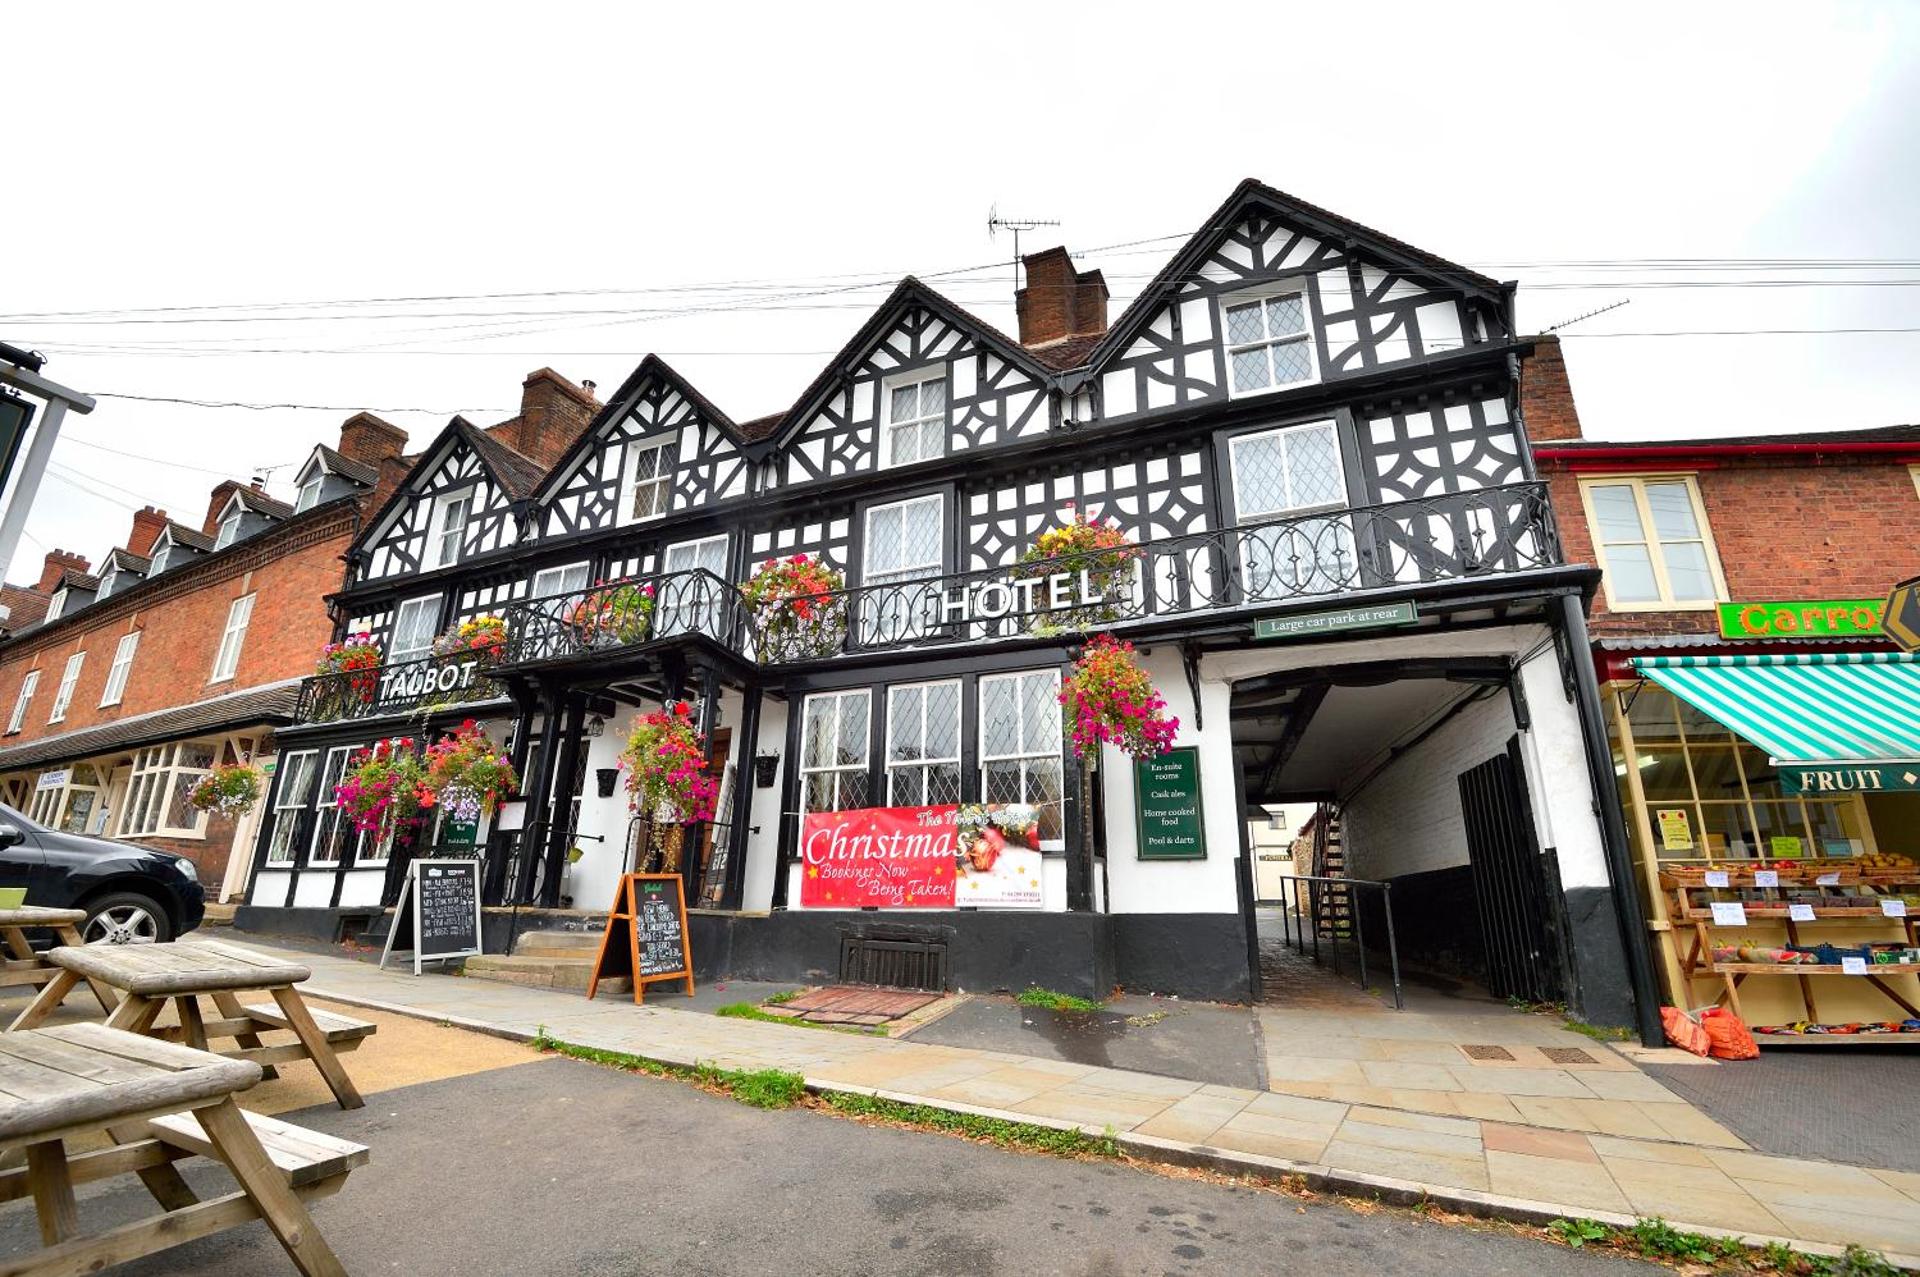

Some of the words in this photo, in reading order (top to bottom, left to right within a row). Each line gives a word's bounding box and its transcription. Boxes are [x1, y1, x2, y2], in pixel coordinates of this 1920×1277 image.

[941, 569, 1103, 624] HOTEL
[1270, 620, 1304, 632] Large
[1306, 618, 1326, 627] car
[1329, 612, 1355, 627] park
[1358, 612, 1370, 622] at
[1373, 610, 1398, 620] rear
[379, 661, 478, 701] TALBOT
[1799, 769, 1883, 791] FRUIT
[917, 809, 943, 827] The
[1144, 809, 1167, 817] Home
[1168, 807, 1196, 816] cooked
[1161, 817, 1179, 826] food
[806, 822, 970, 865] Christmas
[1148, 837, 1166, 845] Pool
[1174, 836, 1195, 844] darts
[821, 861, 875, 888] Bookings
[876, 862, 909, 879] Now
[868, 879, 905, 906] Being
[908, 877, 955, 897] Taken!
